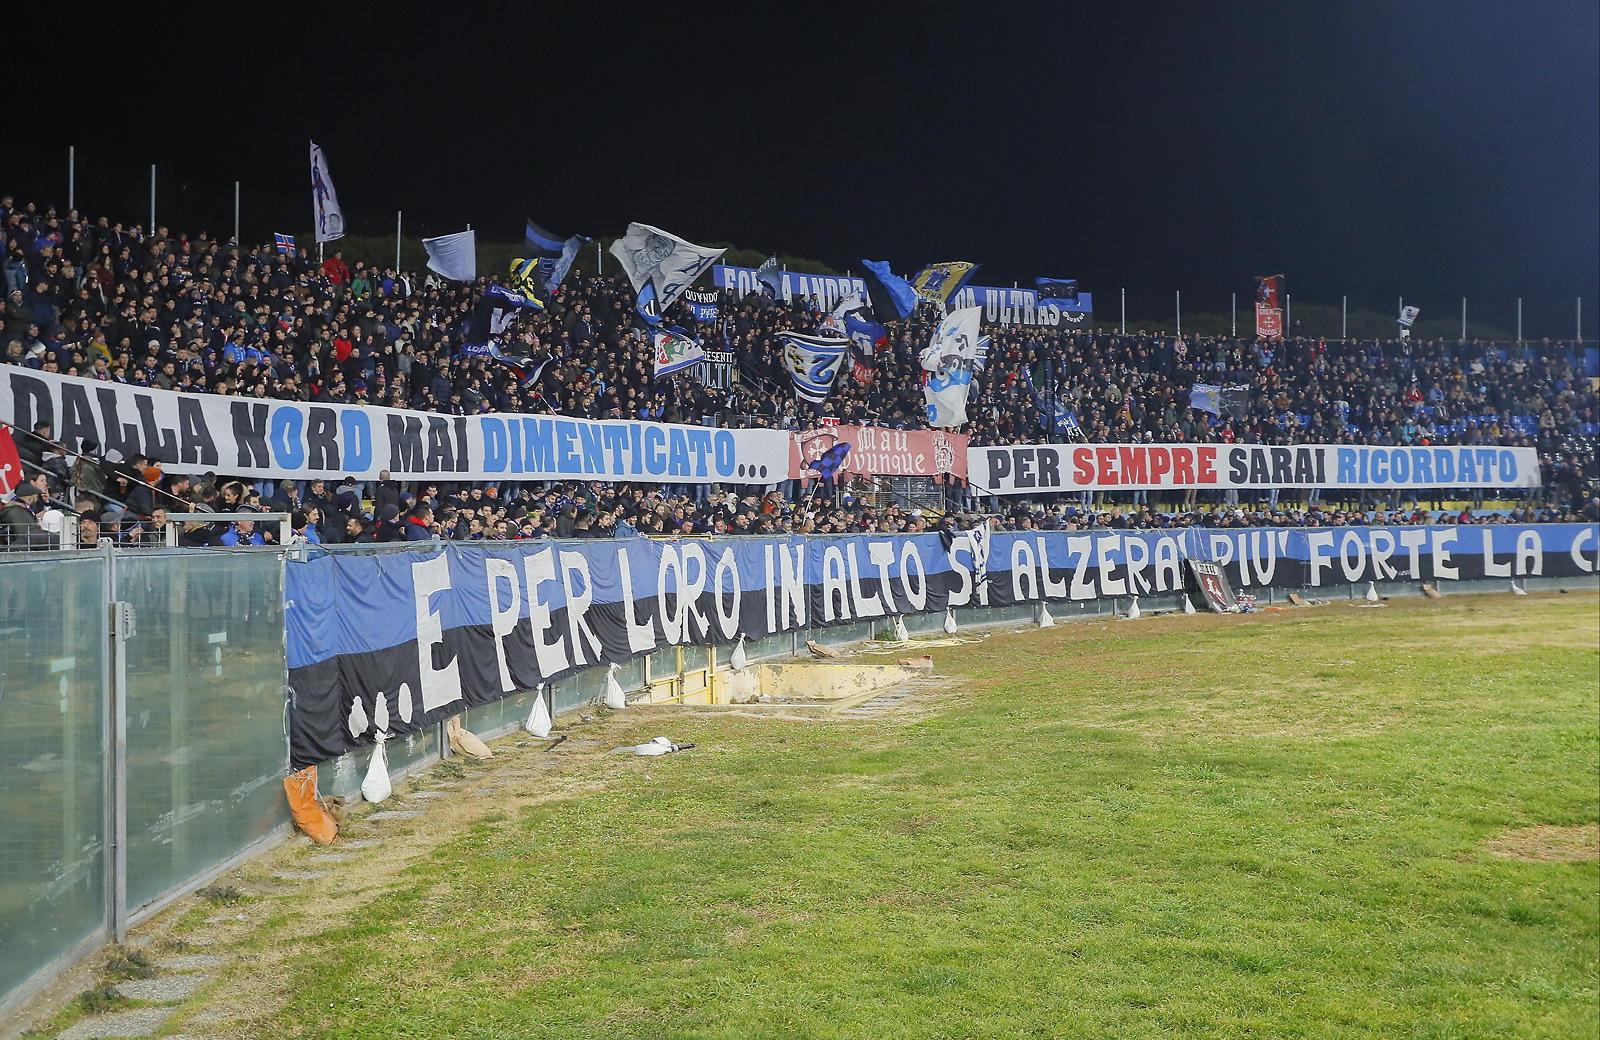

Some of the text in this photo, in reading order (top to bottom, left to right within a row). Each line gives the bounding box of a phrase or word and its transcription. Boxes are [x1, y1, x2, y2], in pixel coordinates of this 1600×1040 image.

[724, 268, 793, 307] FORA
[986, 289, 1060, 326] ULTRAS
[702, 350, 733, 363] RESENTI
[9, 373, 768, 479] DALLA NORD MAI DIMENTICATO...
[857, 427, 908, 453] Mau
[986, 446, 1518, 489] PER SEMPRE SARAI RICORDATO
[485, 546, 603, 693] PER
[618, 542, 741, 654] LORO
[764, 543, 806, 633] IN
[823, 540, 927, 622] ALTO
[1011, 530, 1188, 601] ALZERA'
[1308, 528, 1459, 587] FORTE
[1483, 529, 1543, 577] LA
